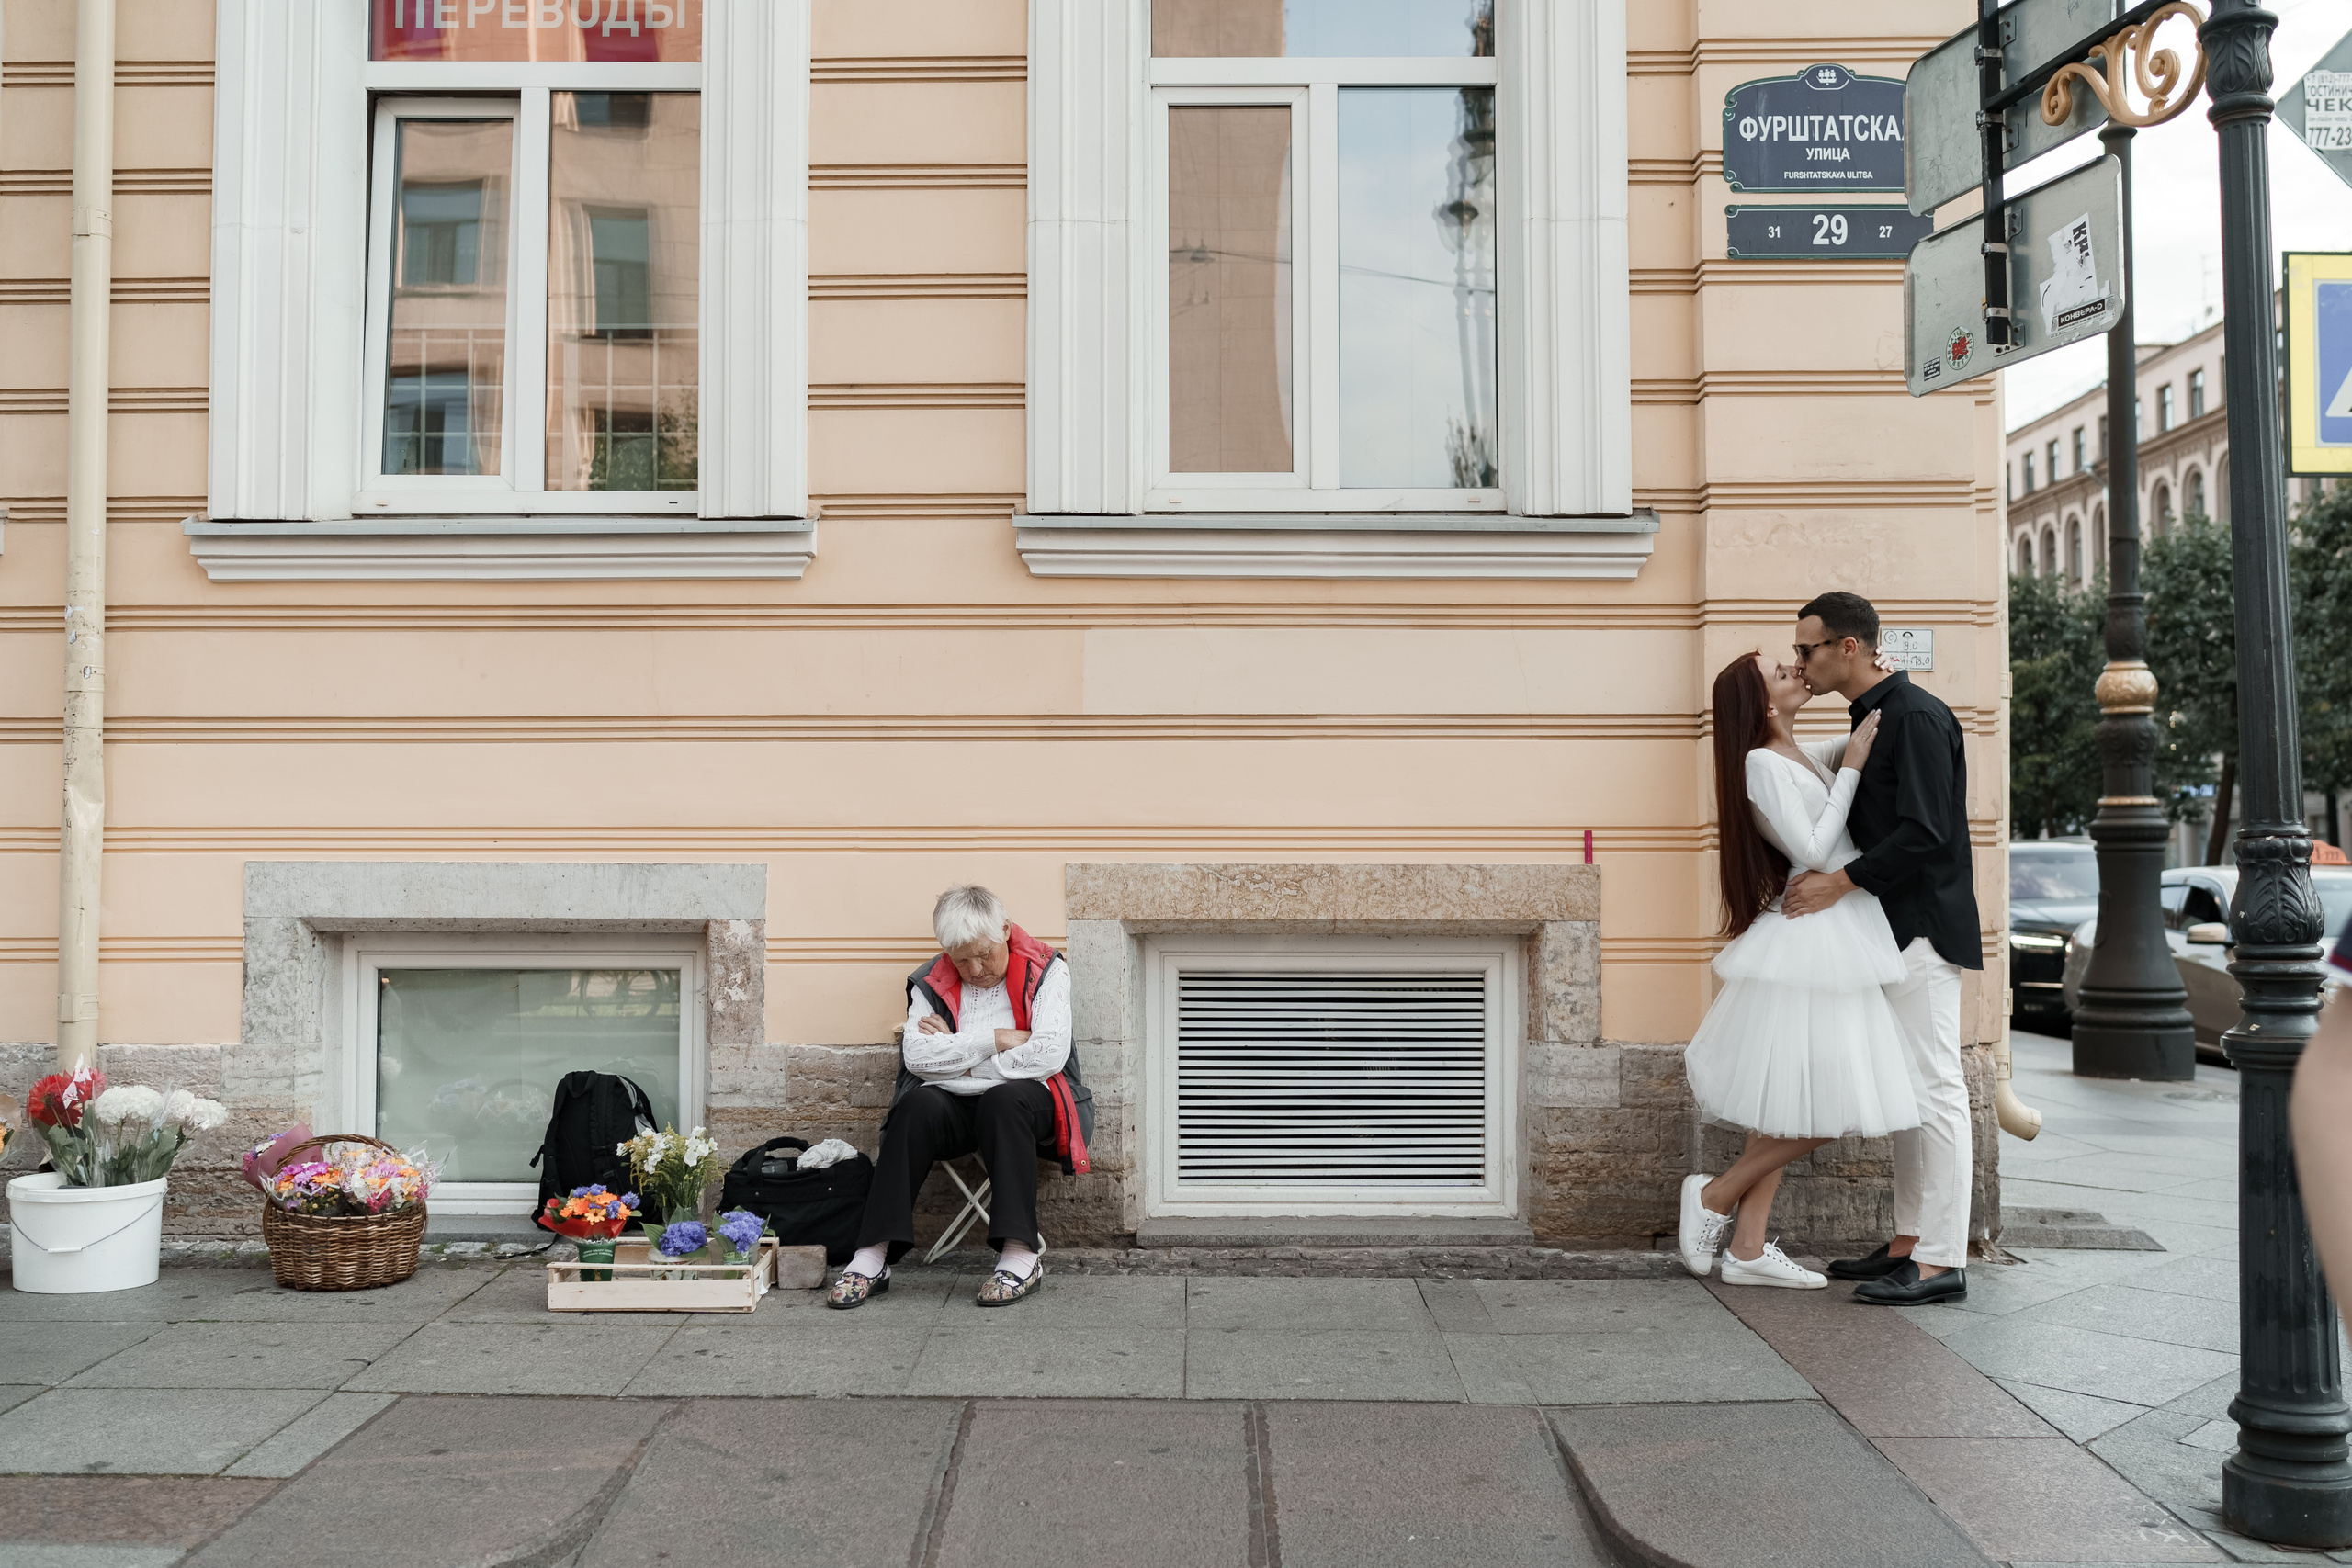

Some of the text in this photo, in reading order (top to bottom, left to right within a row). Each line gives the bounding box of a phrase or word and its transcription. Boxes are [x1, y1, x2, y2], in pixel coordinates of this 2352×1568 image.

[394, 0, 686, 37] ПЕРЕВОДЫ
[1739, 115, 1905, 141] ФУРШТАТСКА
[1805, 147, 1850, 162] УЛИЦА
[1783, 171, 1873, 179] FURSHTATSKAYA ULITSA
[1768, 214, 1893, 245] 31 29 27
